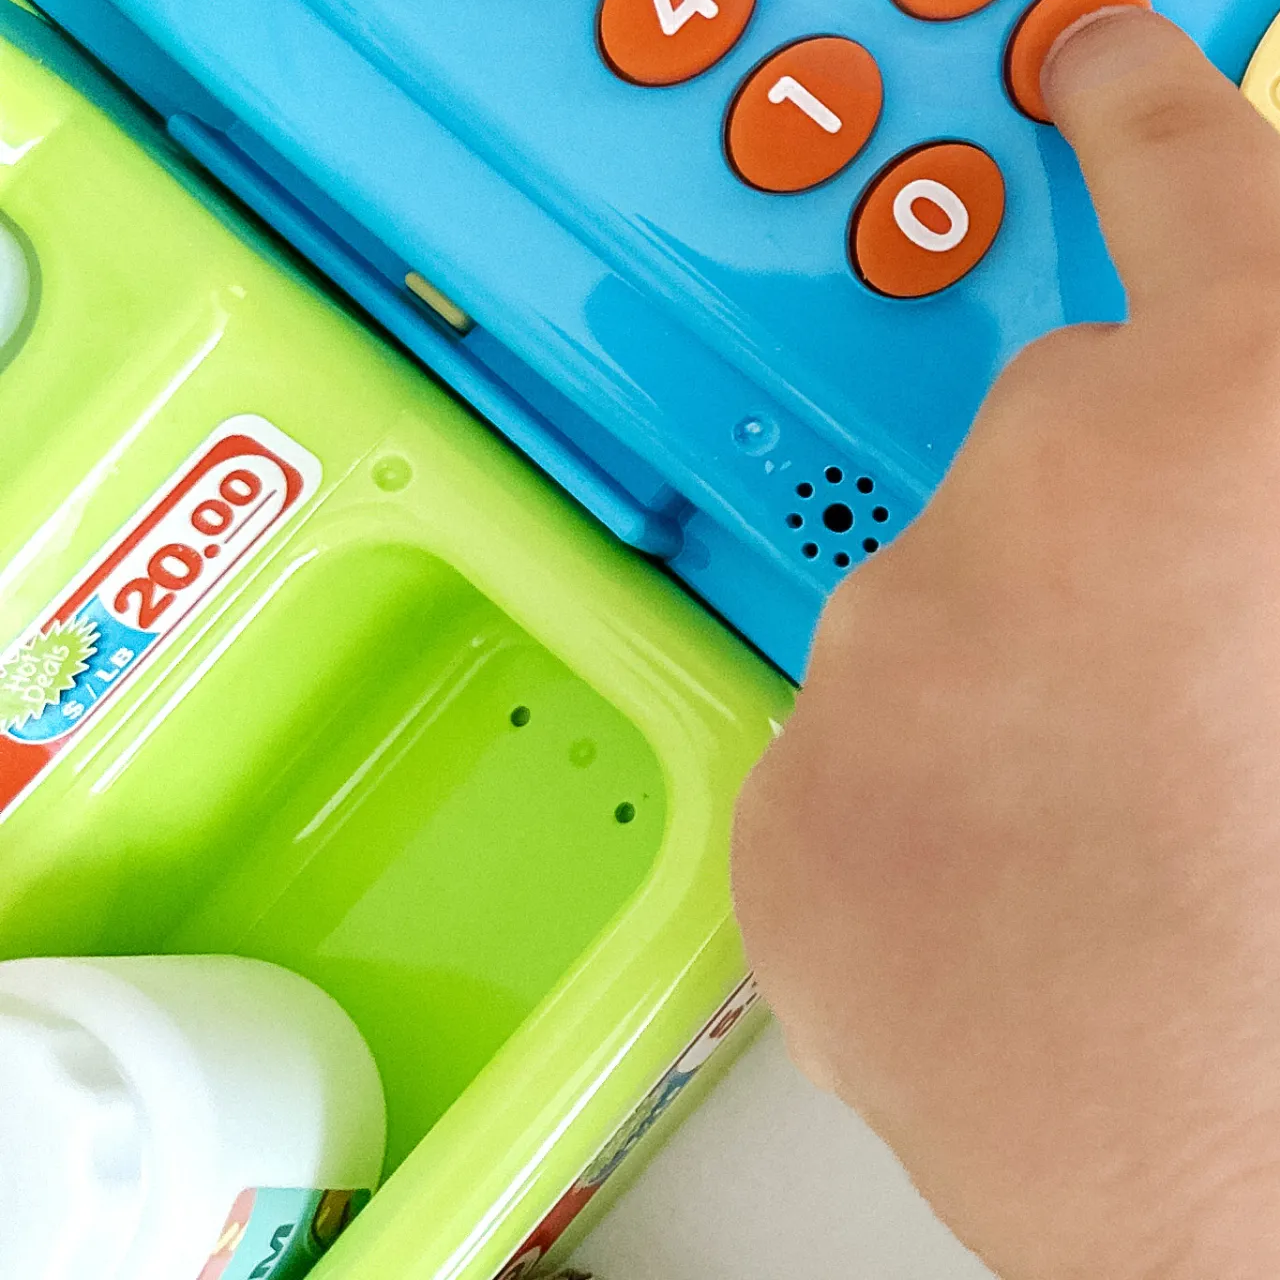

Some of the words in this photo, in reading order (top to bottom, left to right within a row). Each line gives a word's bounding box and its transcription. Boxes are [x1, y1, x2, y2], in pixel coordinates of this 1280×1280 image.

[767, 75, 842, 134] 1
[892, 178, 969, 252] 0
[114, 468, 262, 630] 20.00
[5, 654, 40, 691] Hot
[20, 645, 70, 703] Deals
